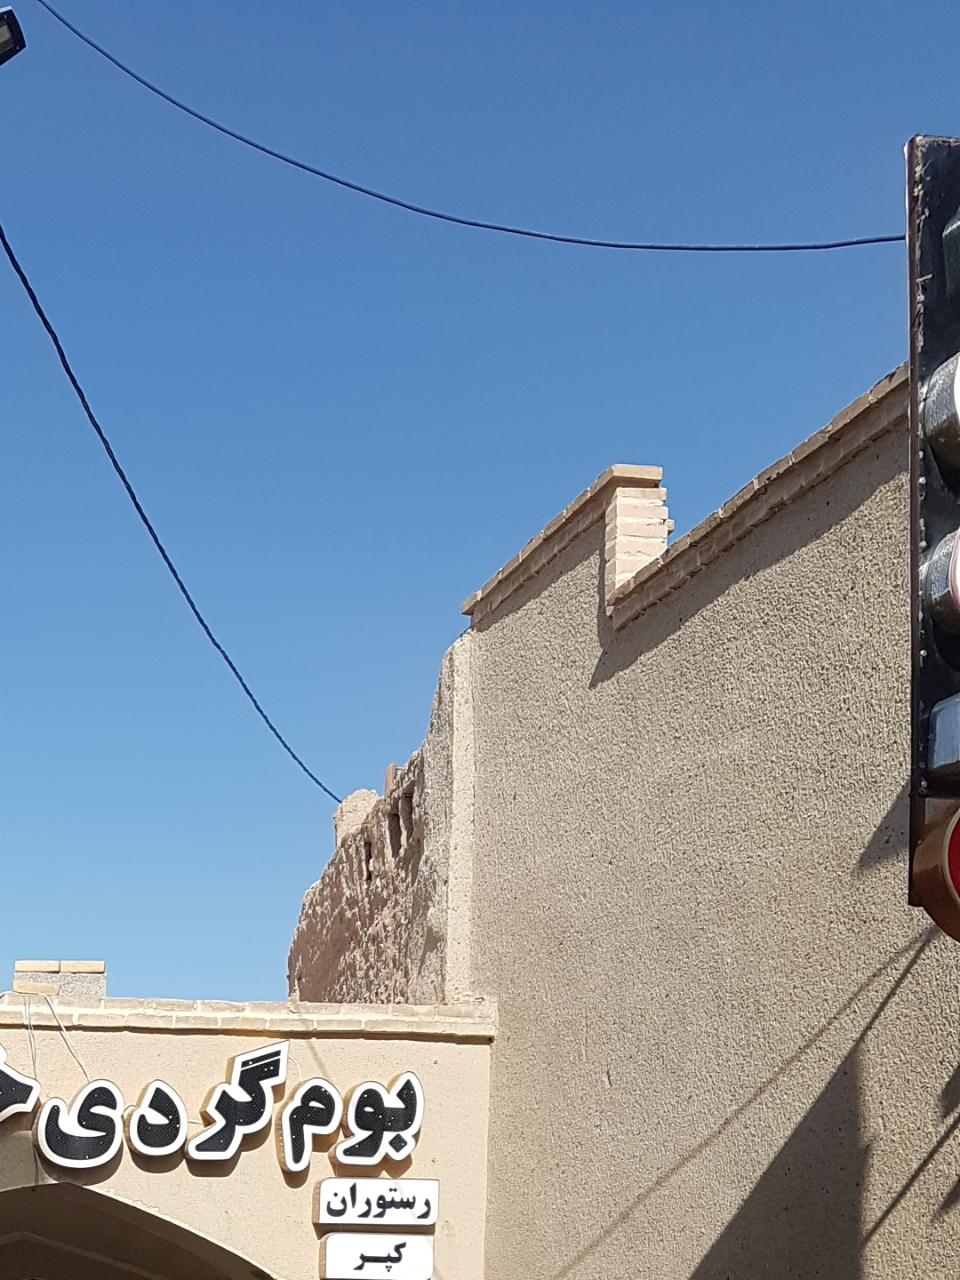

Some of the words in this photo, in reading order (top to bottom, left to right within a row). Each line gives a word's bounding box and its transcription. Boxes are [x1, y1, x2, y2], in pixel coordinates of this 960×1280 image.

[41, 1045, 285, 1165] گردی
[287, 1074, 421, 1168] بوم
[326, 1181, 432, 1219] رستوران
